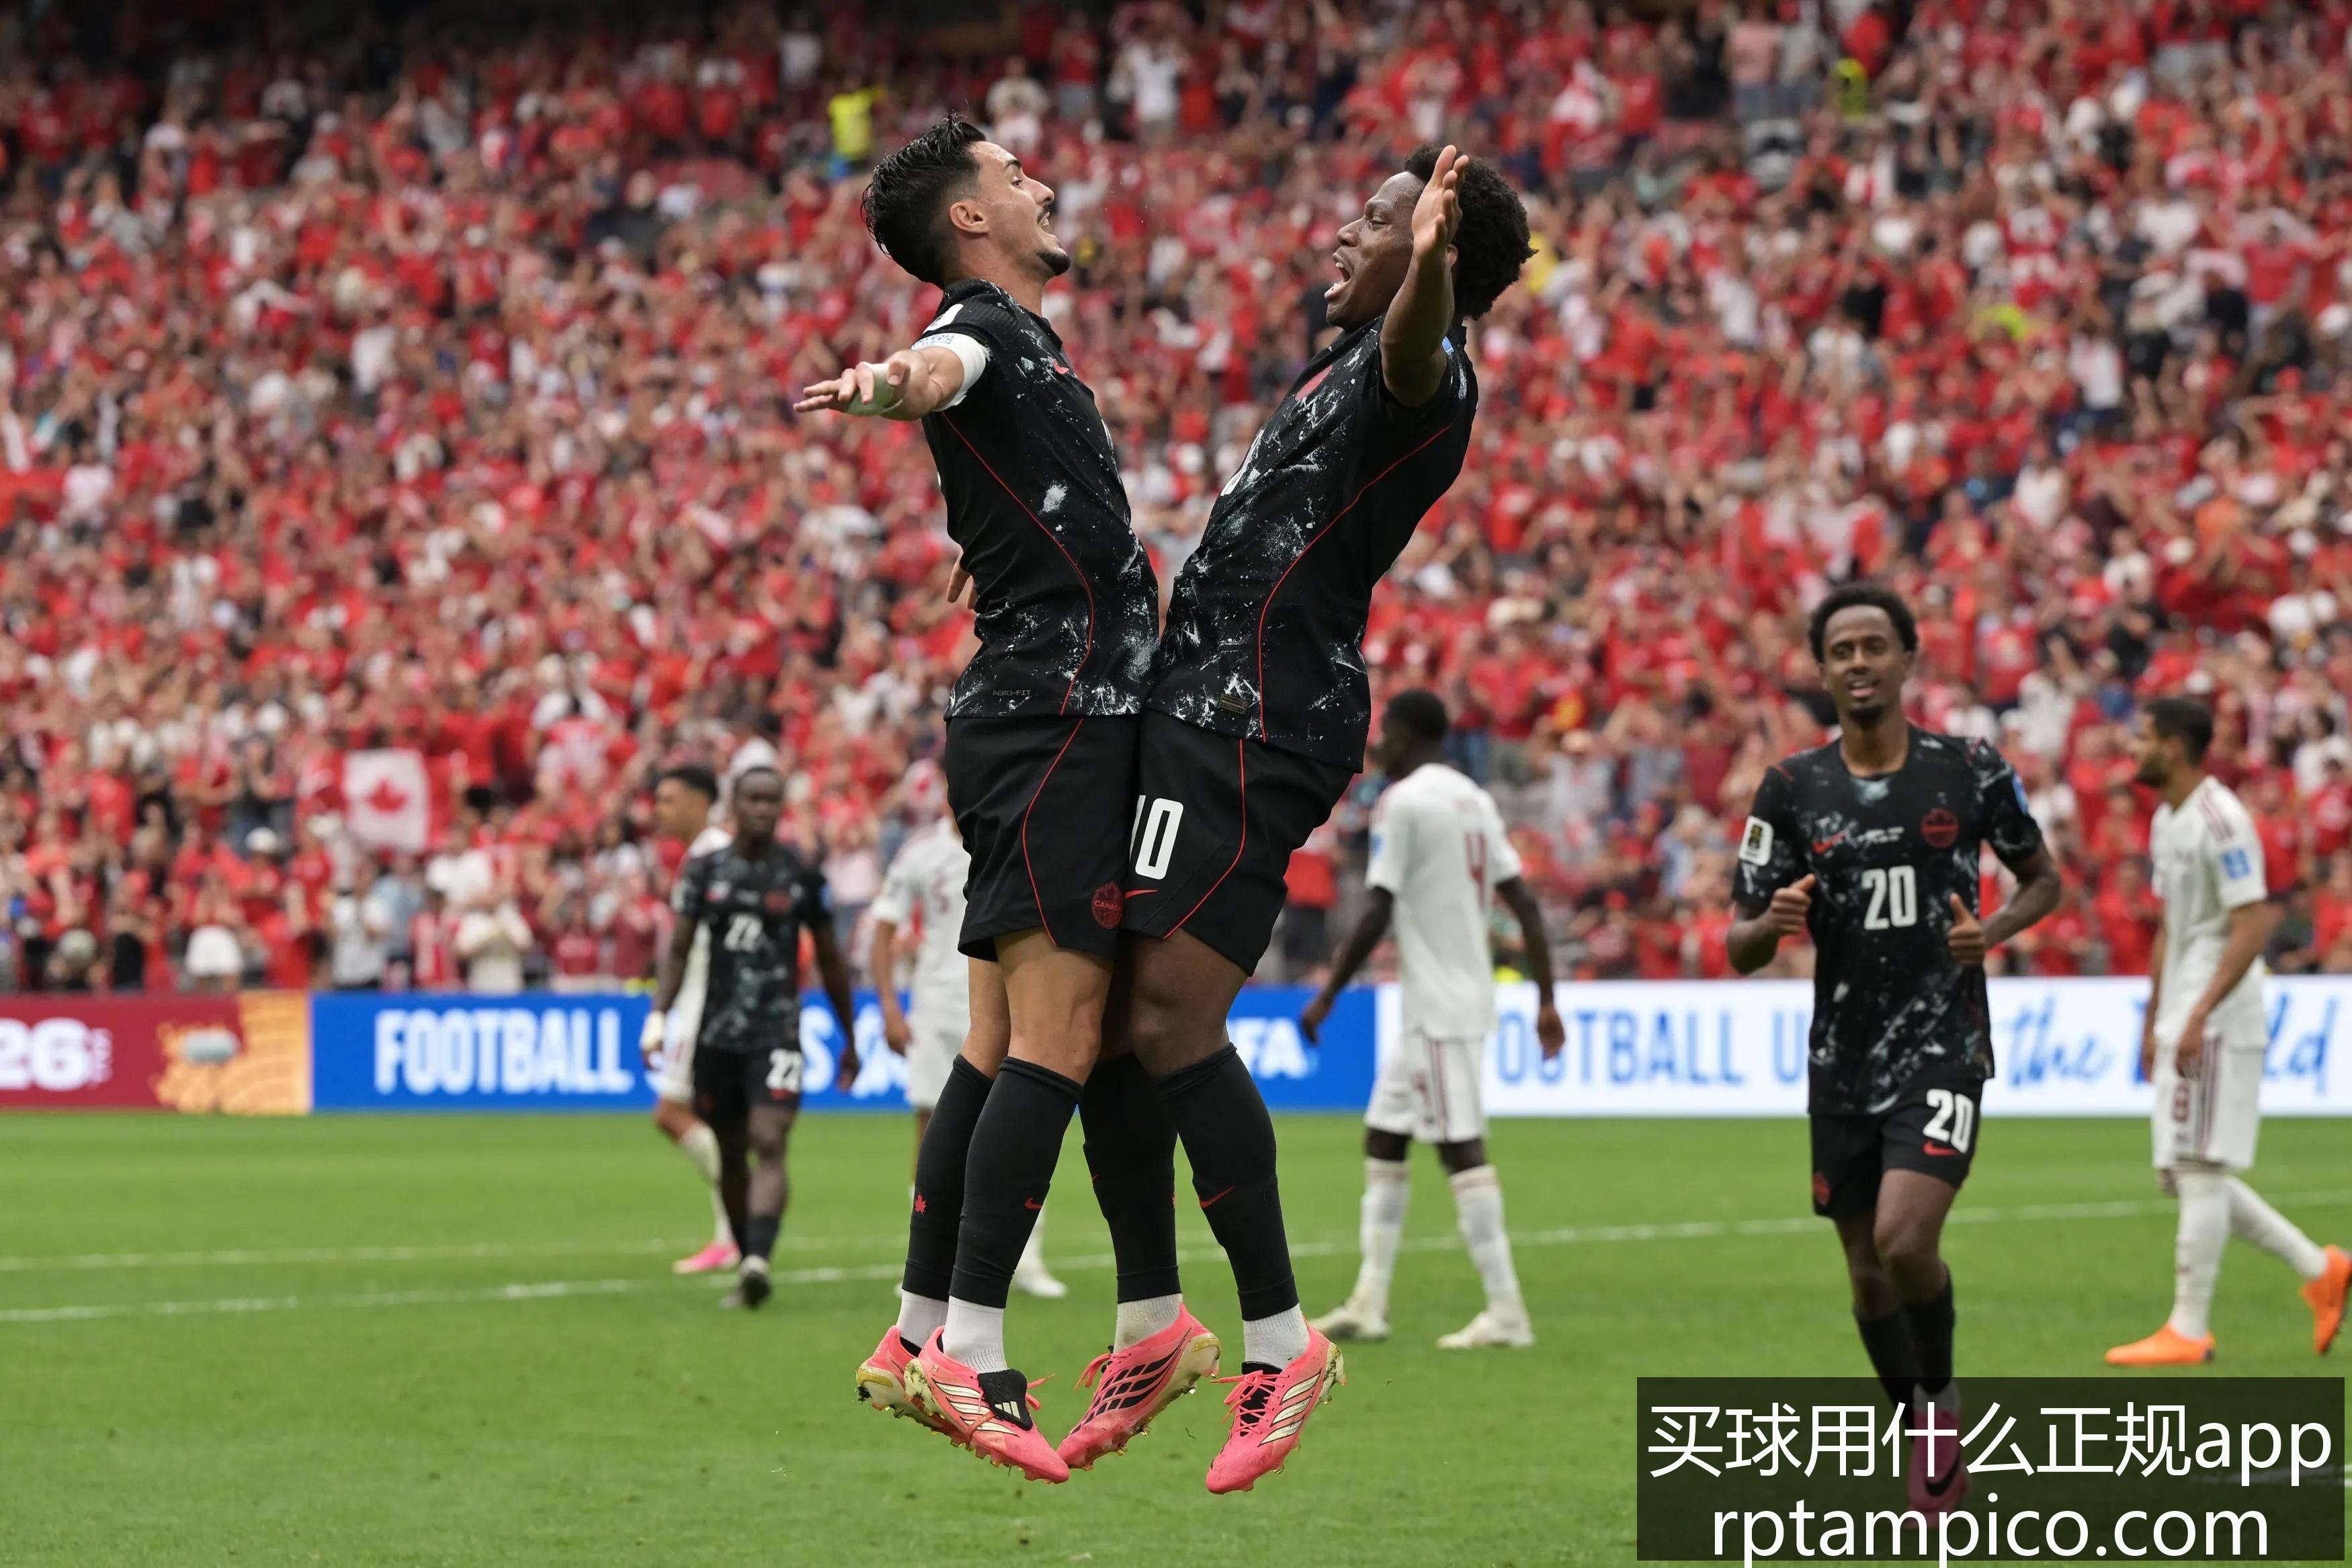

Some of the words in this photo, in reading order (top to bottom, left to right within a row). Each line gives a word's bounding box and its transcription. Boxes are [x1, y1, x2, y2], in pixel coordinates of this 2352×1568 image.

[1861, 865, 1918, 930] 20
[374, 1008, 635, 1096] FOOTBALL
[1922, 1088, 1974, 1154] 20
